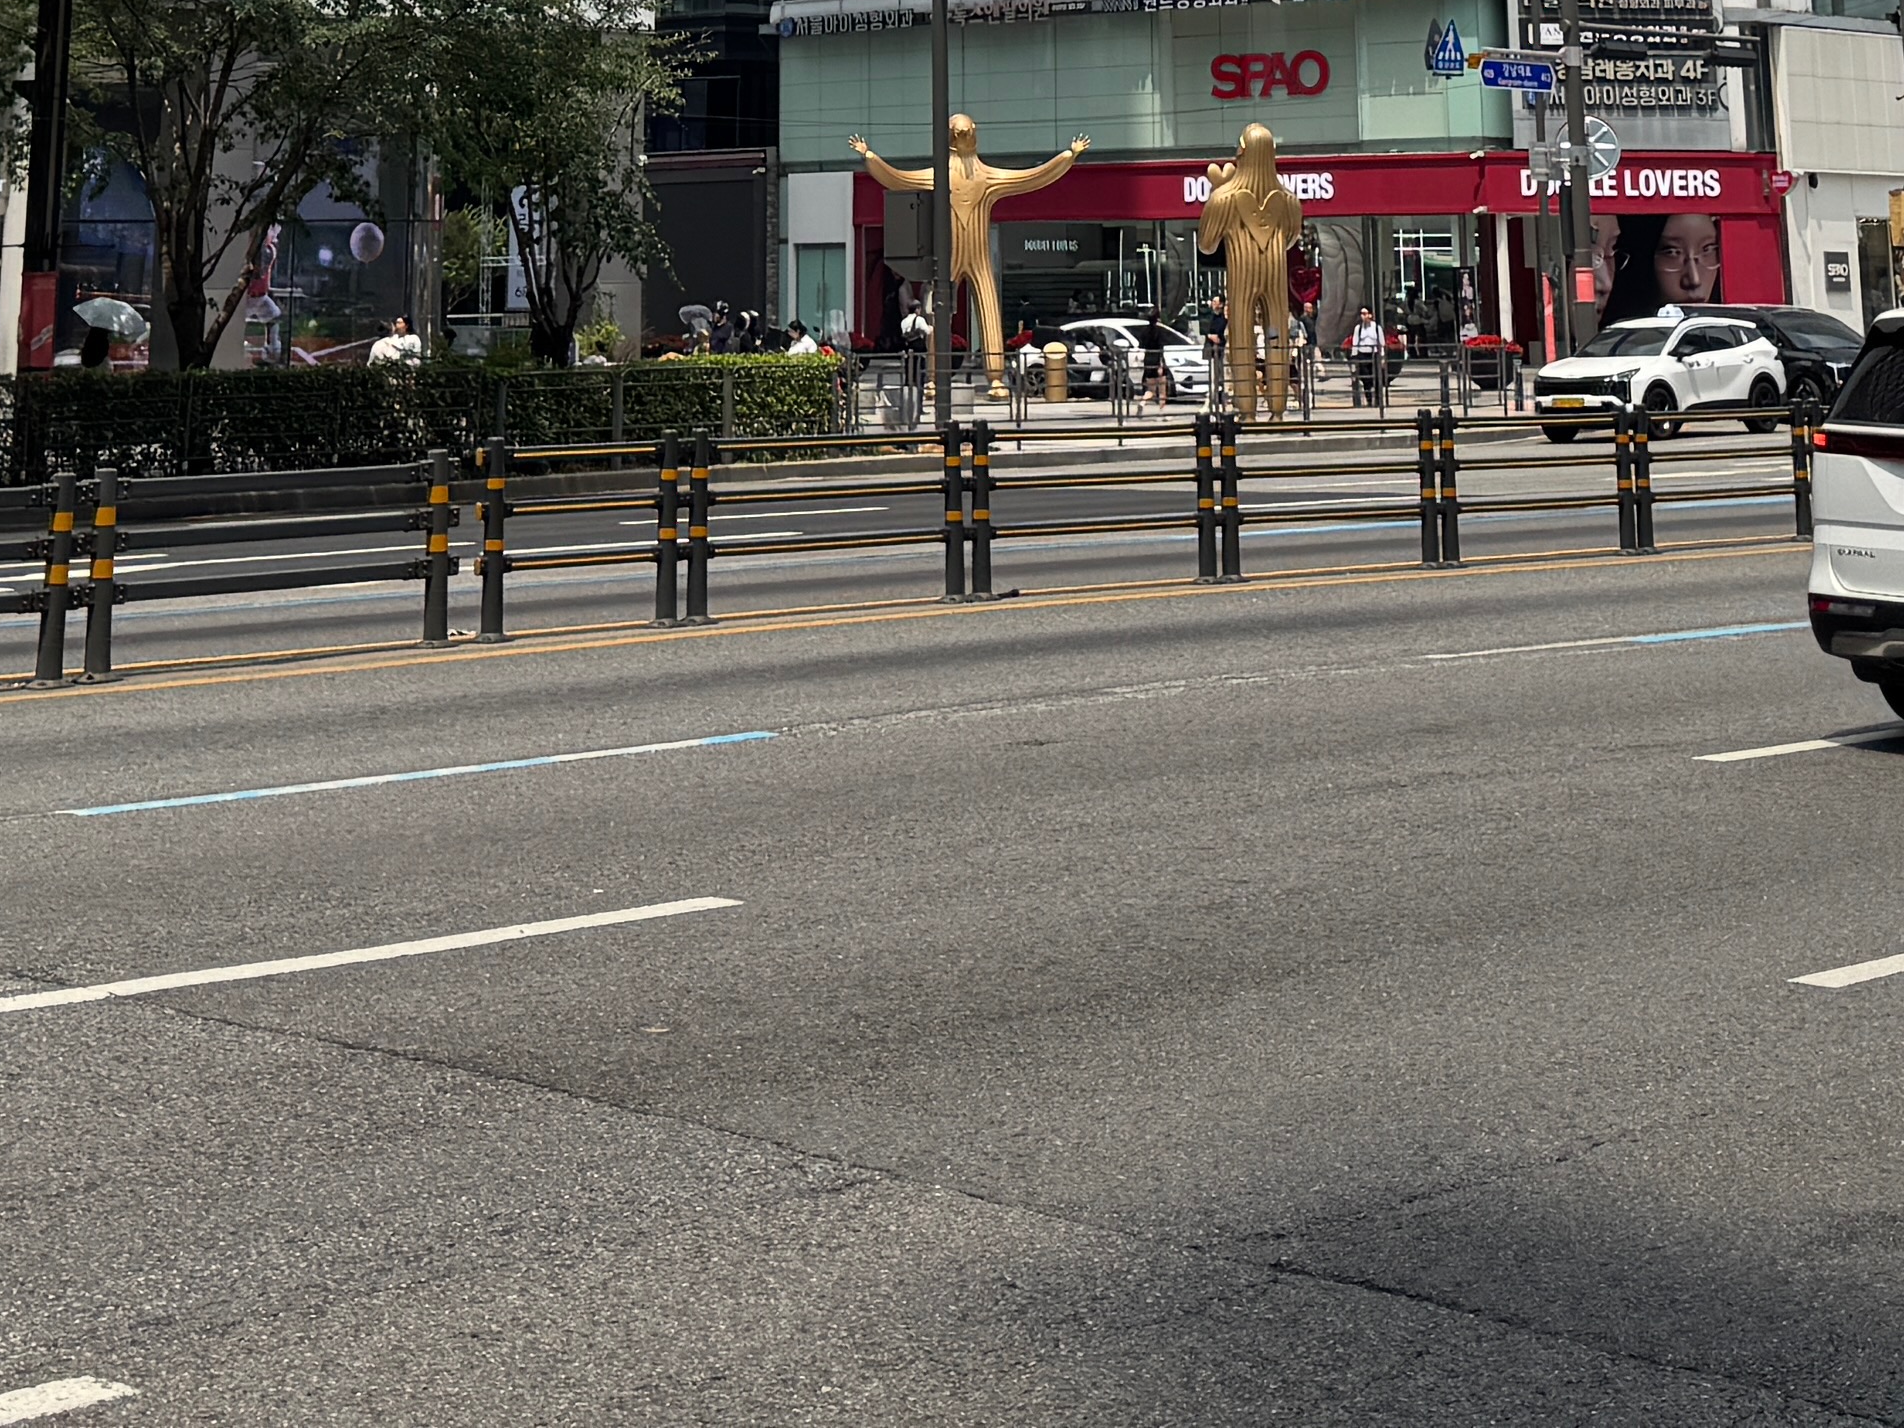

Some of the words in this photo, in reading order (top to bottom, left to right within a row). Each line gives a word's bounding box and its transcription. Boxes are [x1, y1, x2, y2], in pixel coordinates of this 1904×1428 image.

[796, 7, 914, 37] 서울아이성형외과
[1210, 50, 1331, 100] SPAO
[1680, 58, 1709, 81] 4F
[1549, 86, 1692, 107] 서아이성형외과
[1696, 88, 1717, 106] 3F
[1624, 168, 1722, 198] LOVERS
